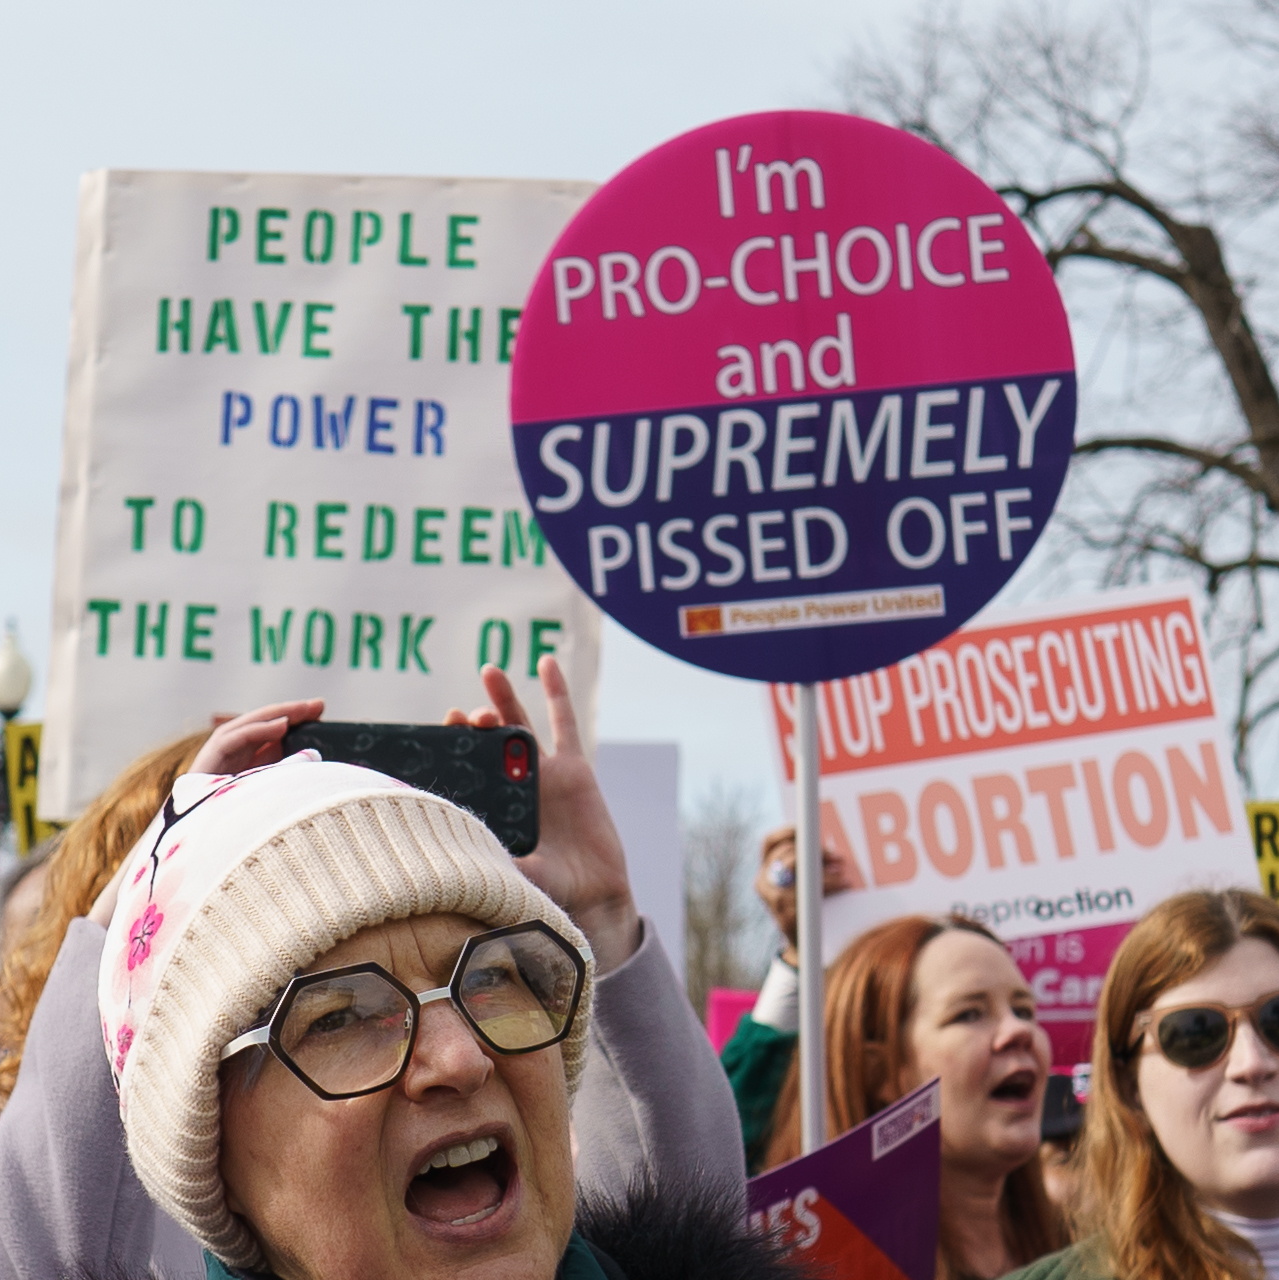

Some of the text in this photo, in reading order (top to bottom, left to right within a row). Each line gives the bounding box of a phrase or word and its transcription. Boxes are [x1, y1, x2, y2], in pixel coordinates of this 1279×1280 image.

[207, 207, 479, 268] PEOPLE
[552, 214, 1010, 324] PRO-CHOICE
[157, 299, 524, 364] HAVE THE
[716, 313, 856, 398] and
[220, 391, 446, 456] POWER
[537, 380, 1061, 512] SUPREMELY
[125, 498, 546, 567] TO REDEEM
[588, 488, 1033, 596] PISSED OFF
[88, 600, 563, 677] THE WORK OF
[898, 612, 1207, 746] PROSECUTING
